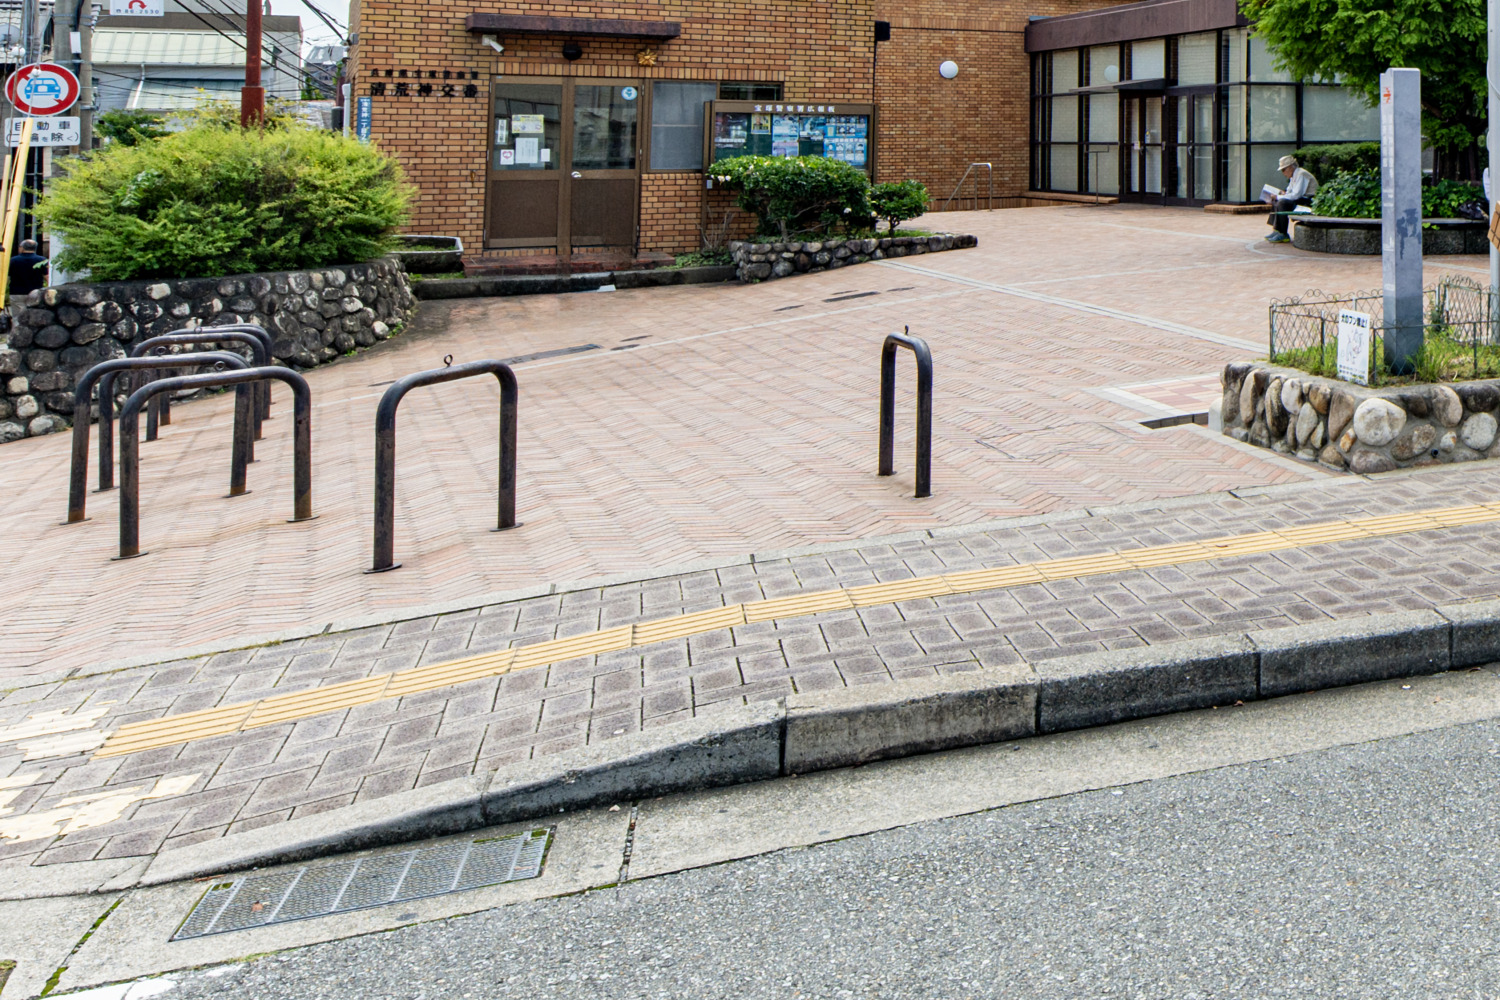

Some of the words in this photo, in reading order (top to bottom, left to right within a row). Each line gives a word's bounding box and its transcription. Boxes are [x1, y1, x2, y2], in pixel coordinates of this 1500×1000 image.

[370, 82, 478, 97] 清荒神交番
